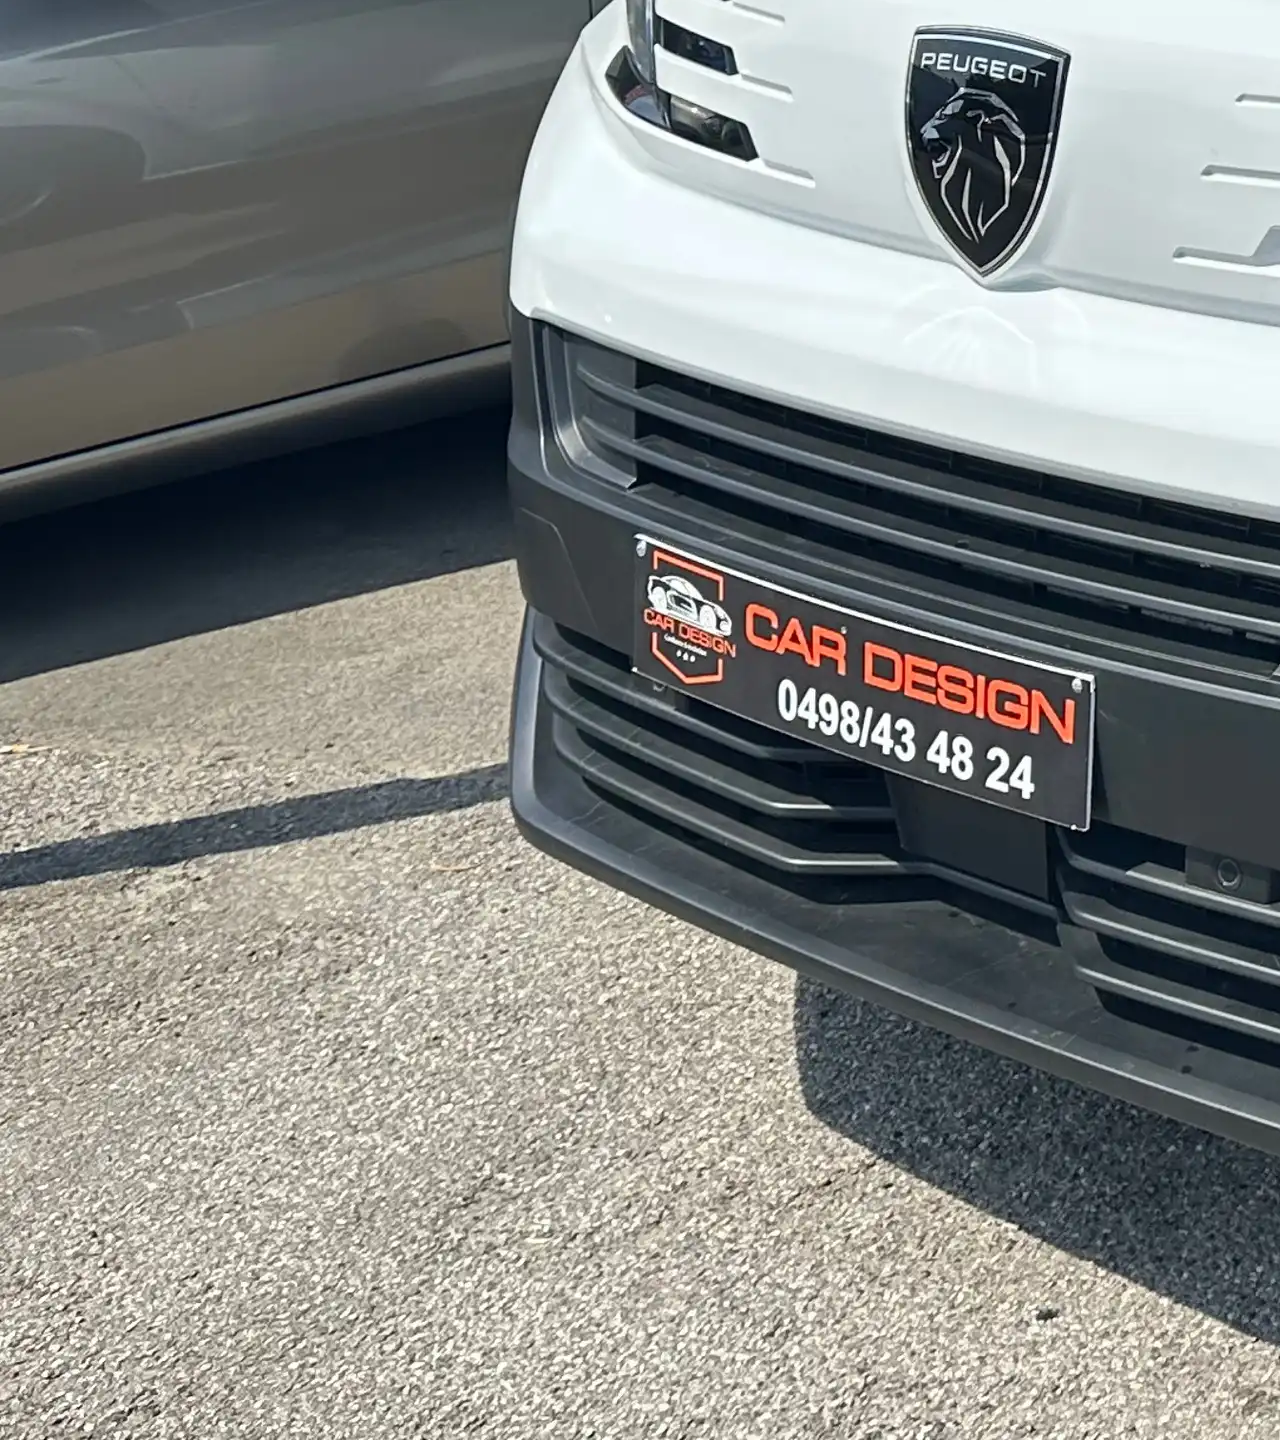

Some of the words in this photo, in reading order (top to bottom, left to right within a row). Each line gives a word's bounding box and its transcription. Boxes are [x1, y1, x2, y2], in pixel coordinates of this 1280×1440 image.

[920, 51, 1047, 88] PEUGEOT
[643, 607, 675, 634] CAR
[678, 623, 737, 658] DESIGN
[745, 603, 848, 675] CAR
[863, 641, 1076, 745] DESIGN
[777, 678, 916, 763] 0498/43
[925, 730, 975, 781] 48
[984, 746, 1036, 800] 24
